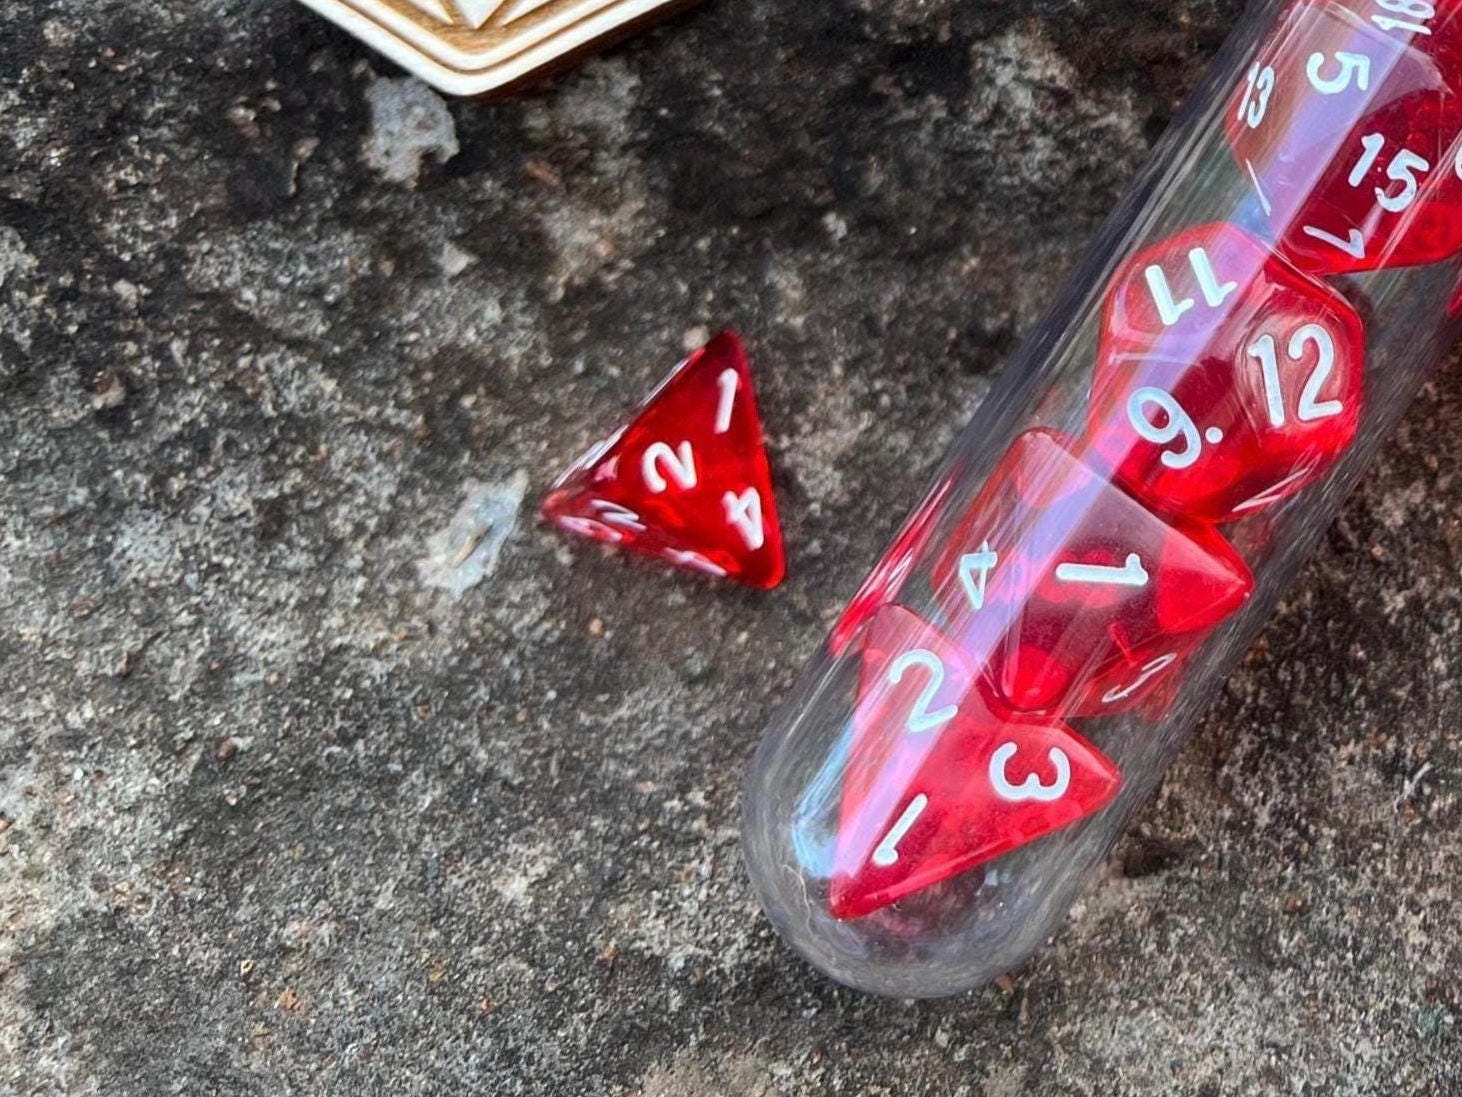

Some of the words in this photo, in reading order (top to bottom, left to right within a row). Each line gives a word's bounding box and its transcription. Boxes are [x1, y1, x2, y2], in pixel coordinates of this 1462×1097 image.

[1237, 61, 1275, 129] 13
[1306, 52, 1370, 94] 5
[1348, 132, 1430, 213] 15
[1145, 247, 1238, 326] 11
[714, 368, 740, 434] 1
[1247, 324, 1343, 428] 12
[641, 441, 697, 492] 2
[722, 487, 765, 550] 4
[959, 540, 998, 610] 4
[1056, 553, 1149, 586] 1
[888, 648, 958, 733] 2
[988, 741, 1071, 801] 3
[872, 793, 928, 866] 1
